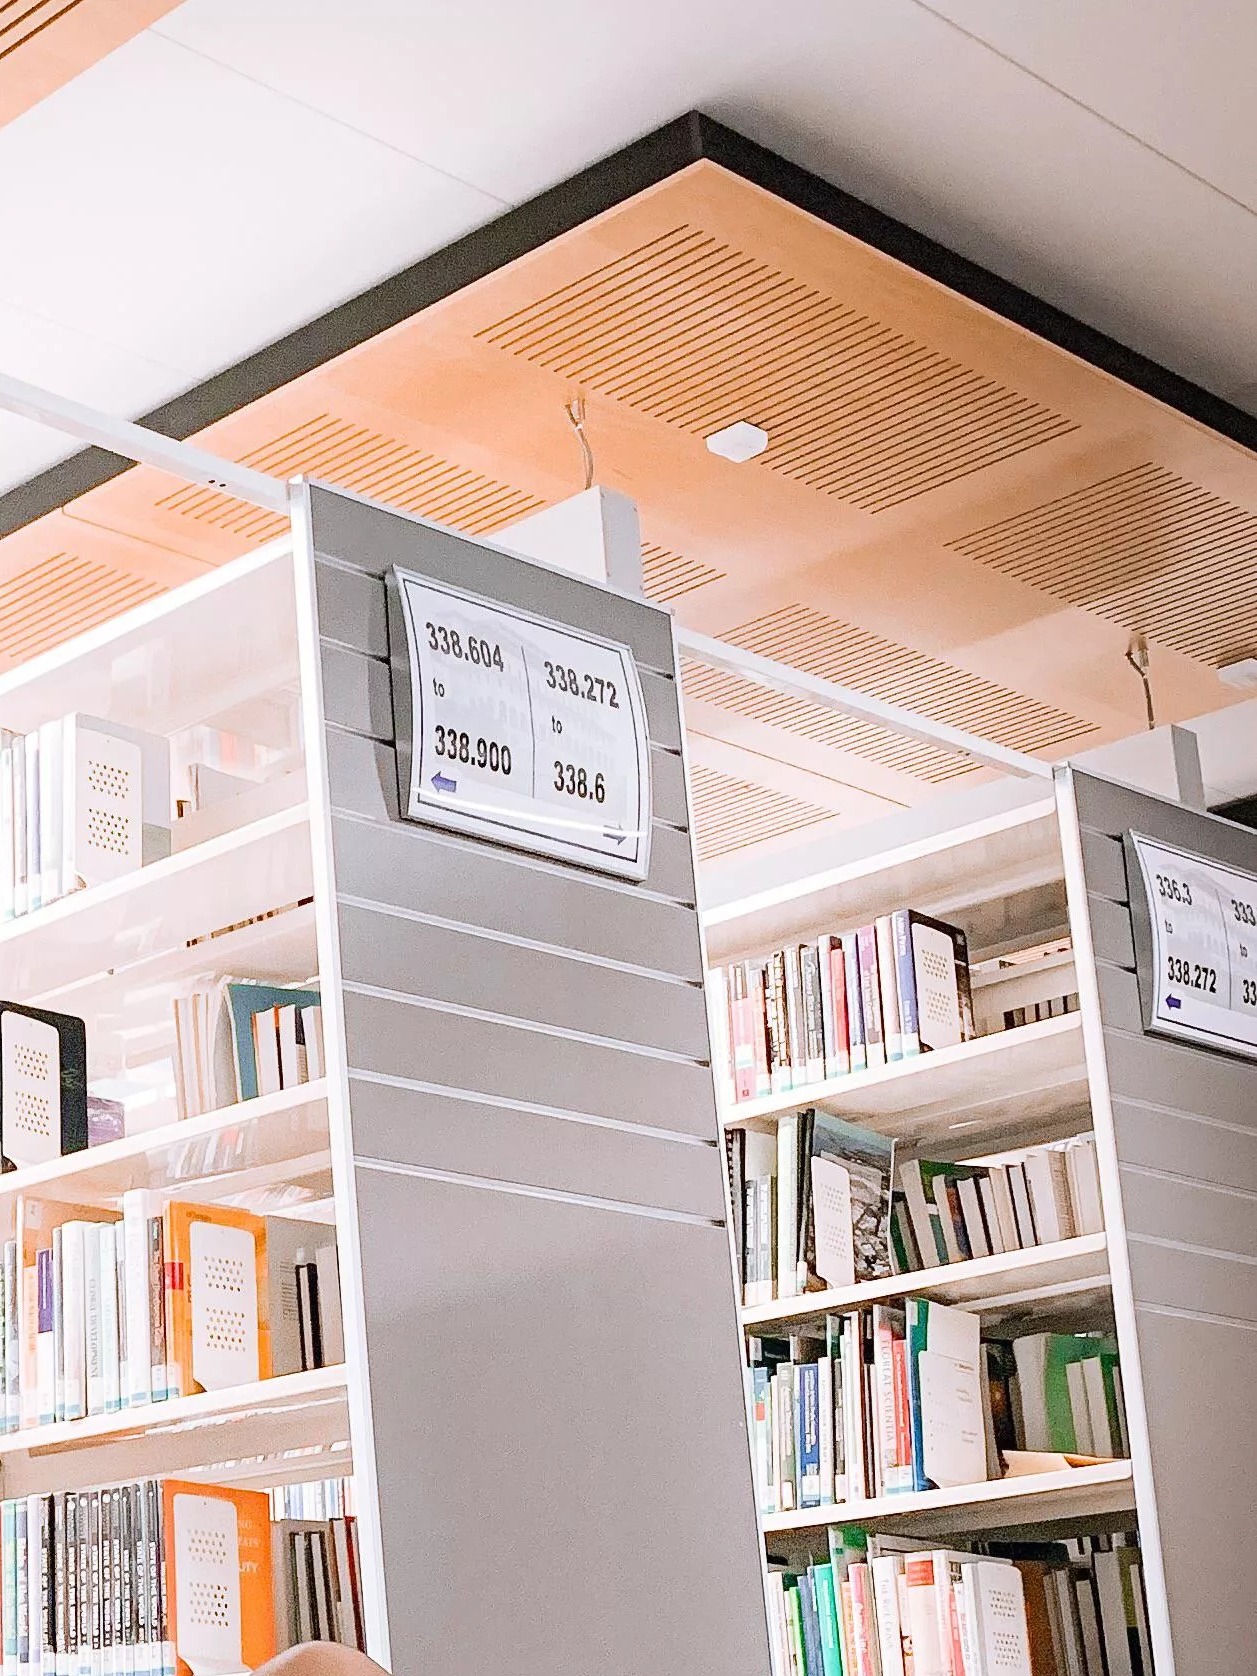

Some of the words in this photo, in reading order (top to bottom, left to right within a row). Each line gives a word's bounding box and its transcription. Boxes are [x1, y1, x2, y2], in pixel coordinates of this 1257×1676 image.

[426, 622, 504, 672] 338.604
[433, 677, 445, 698] to
[544, 661, 619, 709] 338.272
[552, 715, 563, 734] to
[435, 725, 512, 775] 338.900
[554, 761, 605, 803] 338.6
[1156, 874, 1192, 905] 336.3
[1168, 956, 1217, 994] 338.272
